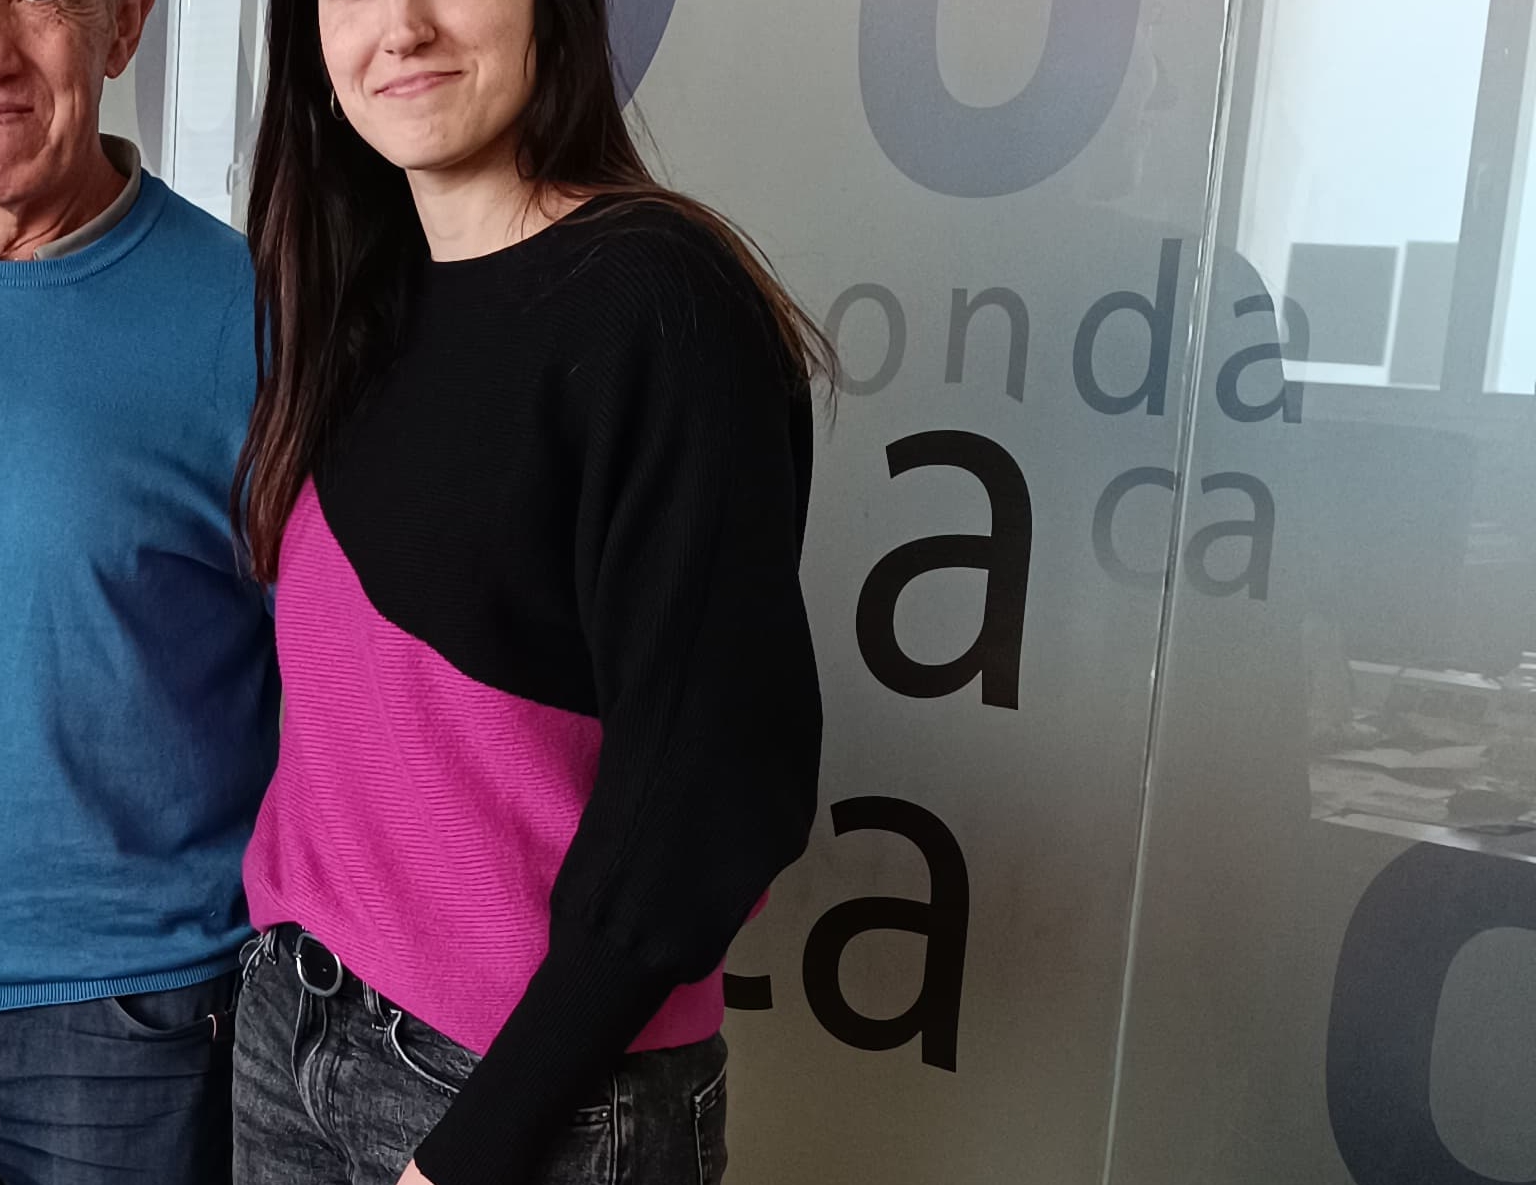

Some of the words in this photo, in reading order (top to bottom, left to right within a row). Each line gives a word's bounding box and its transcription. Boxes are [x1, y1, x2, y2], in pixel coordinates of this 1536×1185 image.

[821, 238, 1311, 425] onda
[855, 429, 1033, 712] a
[1091, 465, 1276, 602] ca
